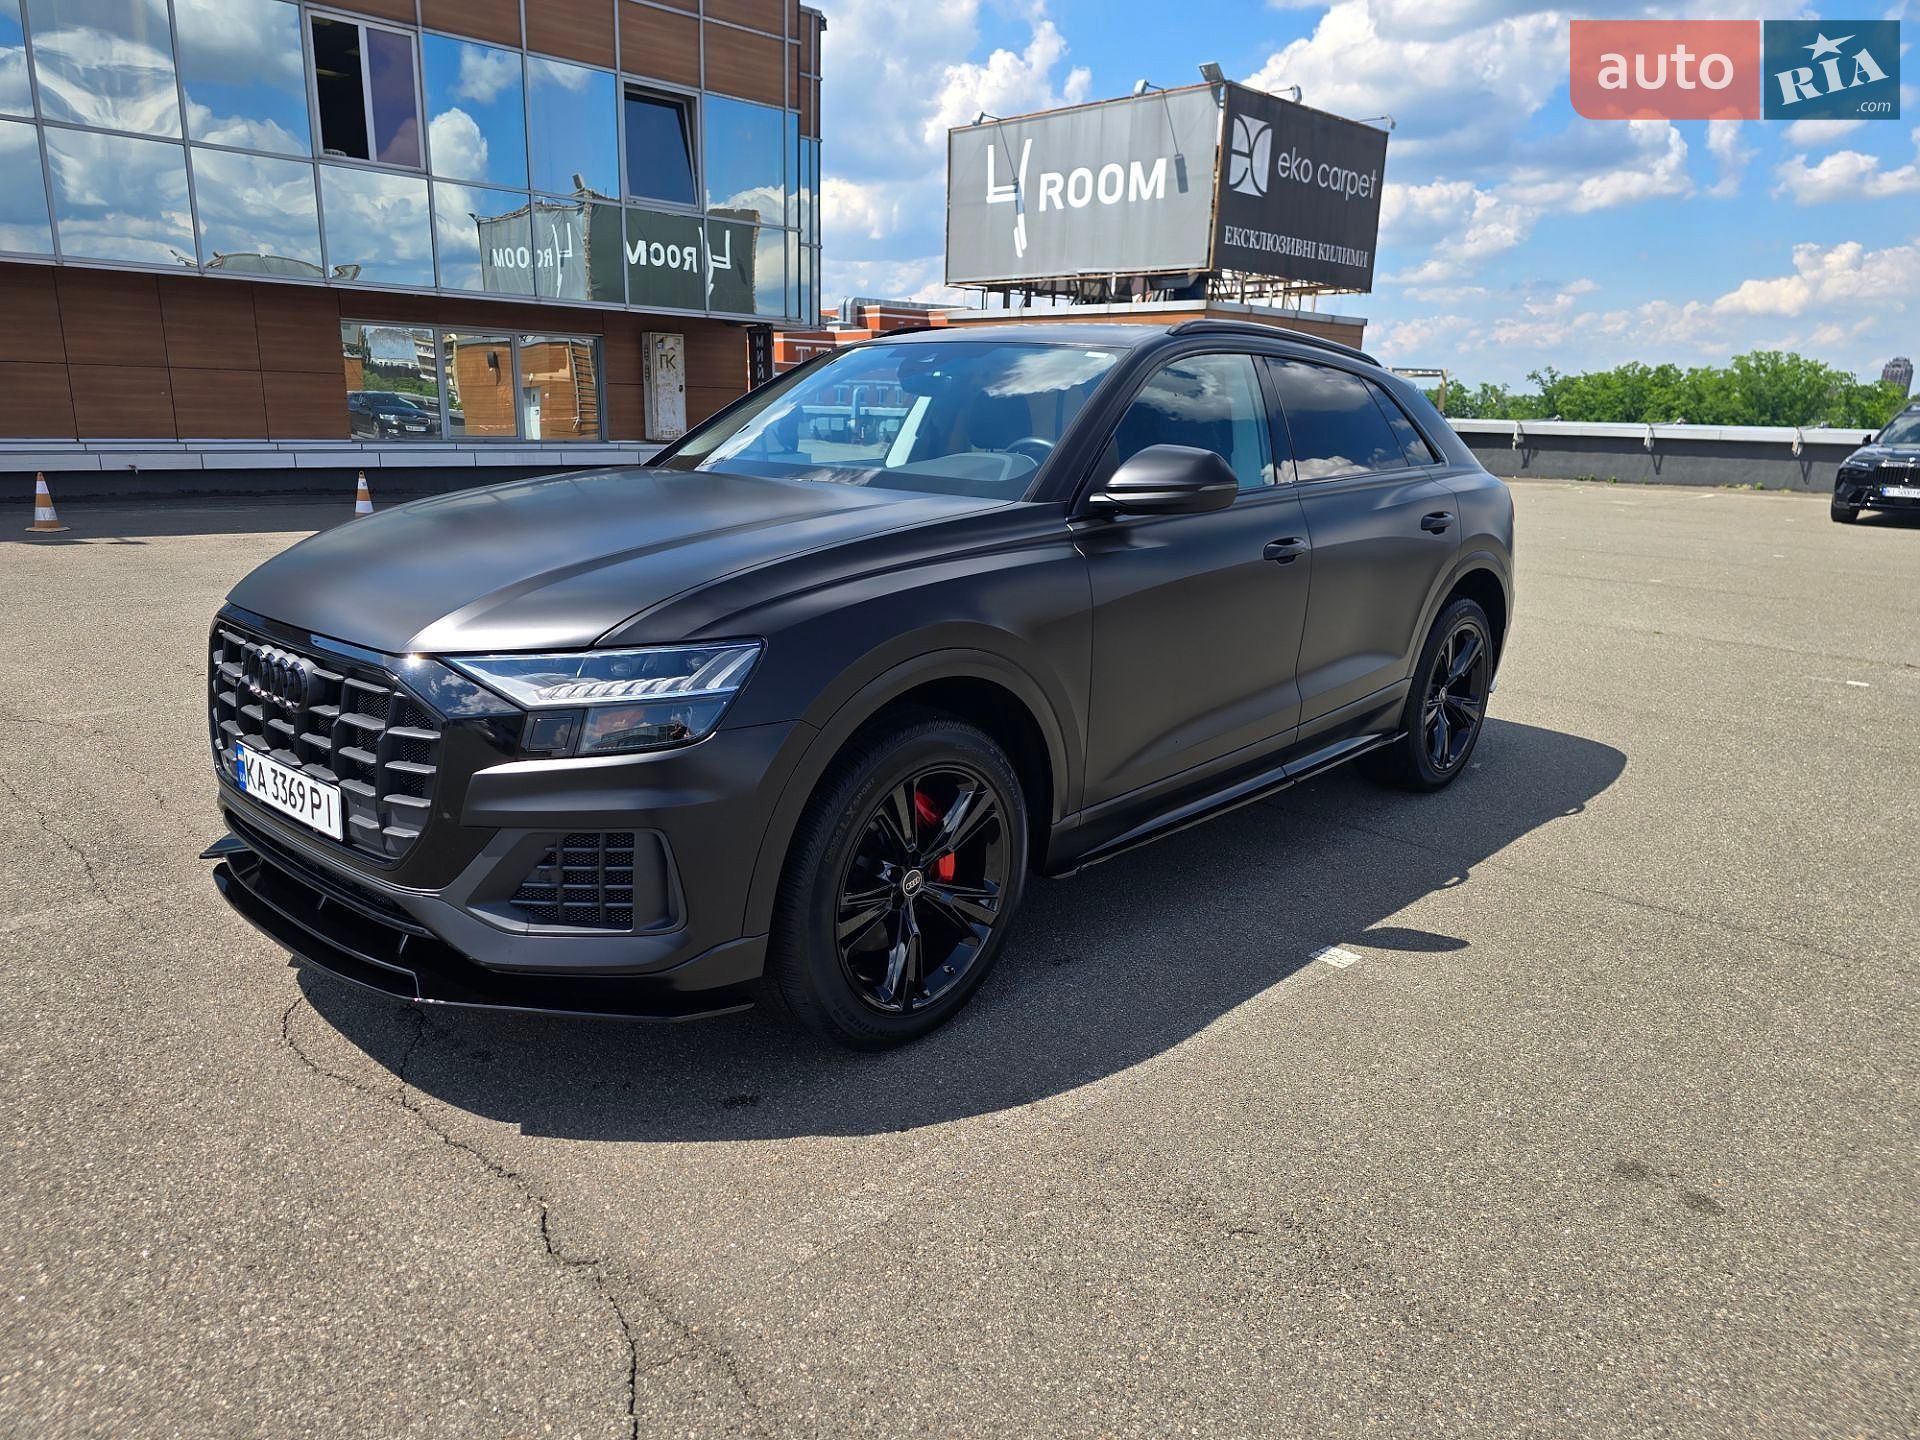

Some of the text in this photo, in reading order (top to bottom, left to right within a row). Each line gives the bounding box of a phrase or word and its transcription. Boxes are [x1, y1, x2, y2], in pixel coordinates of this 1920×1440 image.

[1038, 157, 1168, 213] ROOM
[1277, 146, 1377, 201] eko carpet
[1224, 224, 1369, 268] ЕКСКЛЮЗИВНІ КИЛИМИ
[247, 755, 332, 828] KA 3369 PI
